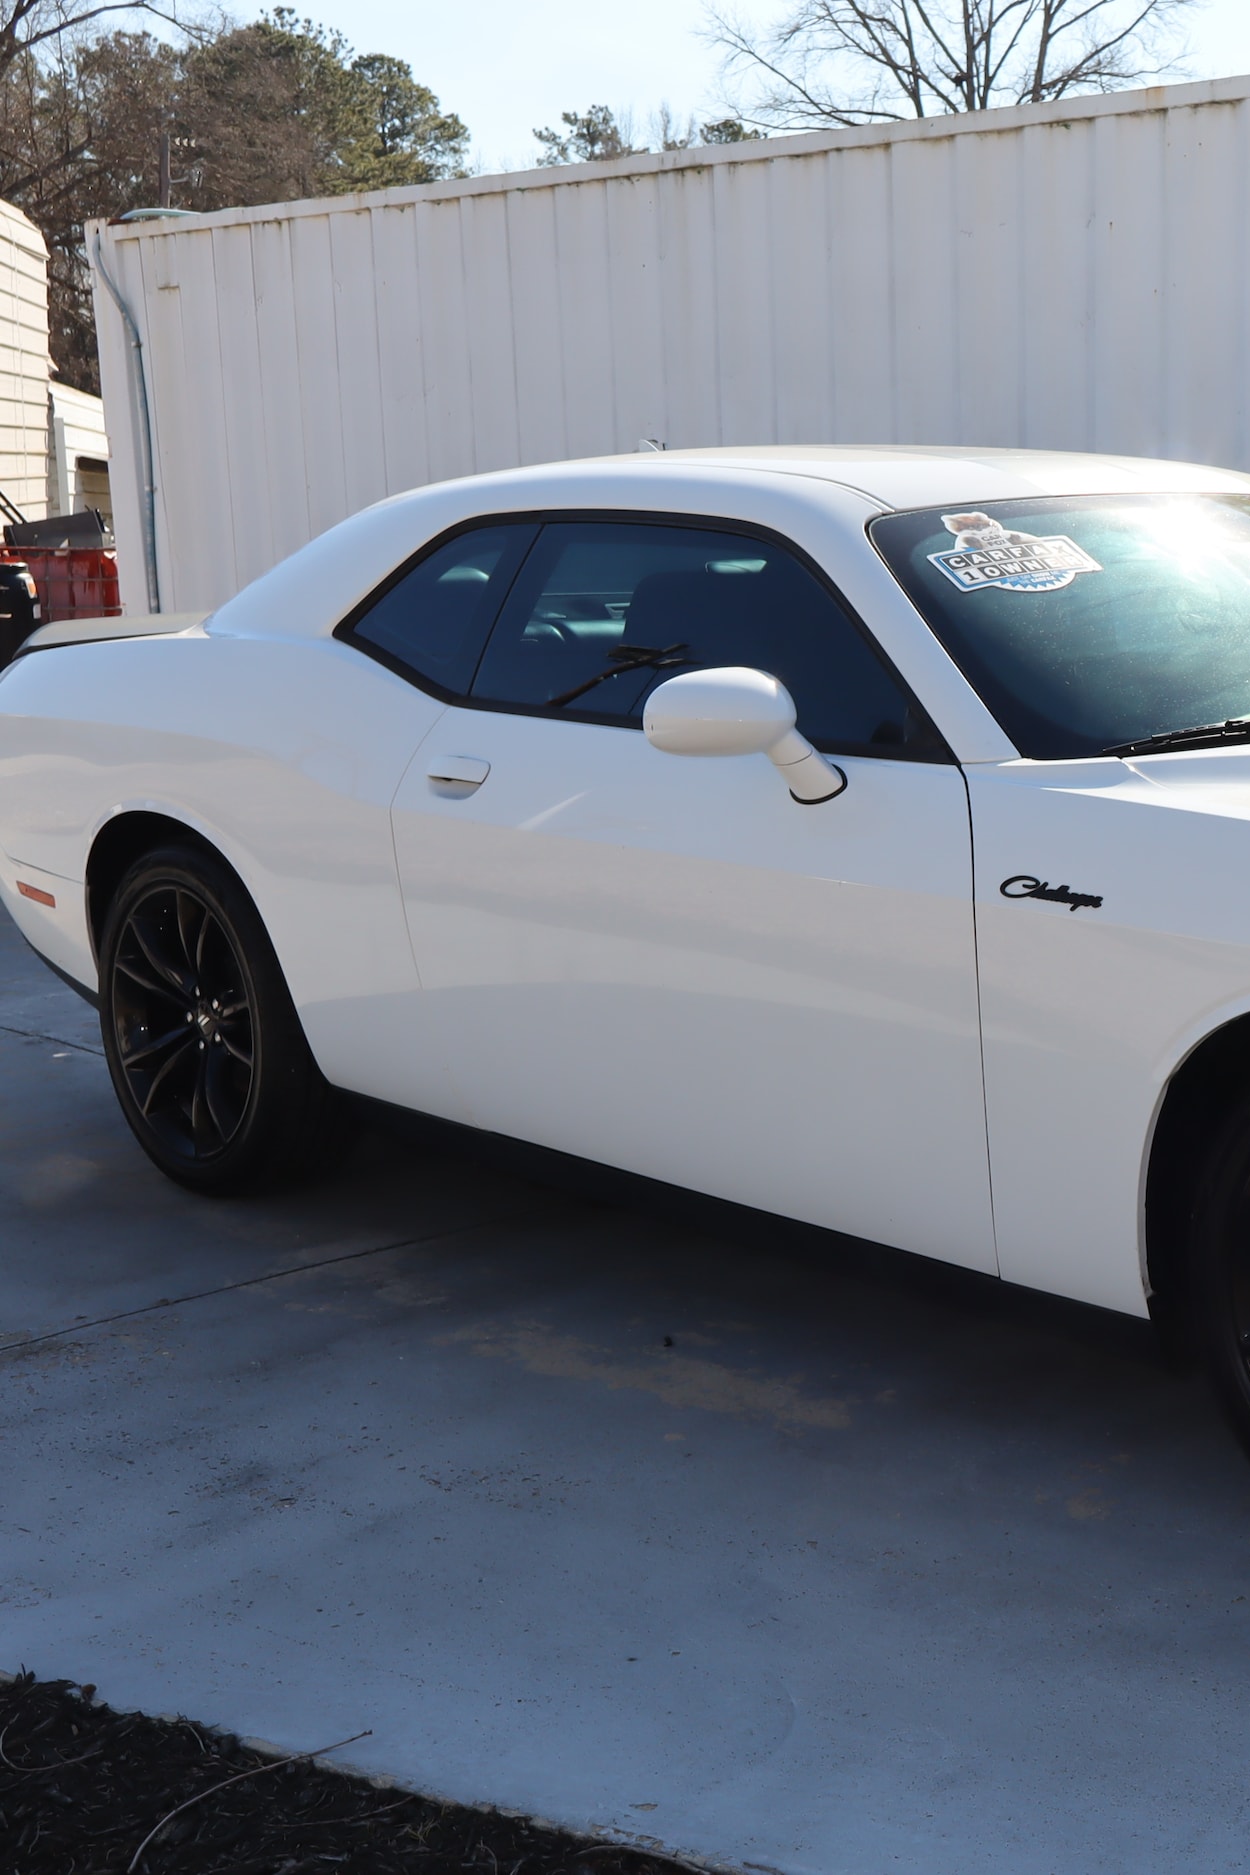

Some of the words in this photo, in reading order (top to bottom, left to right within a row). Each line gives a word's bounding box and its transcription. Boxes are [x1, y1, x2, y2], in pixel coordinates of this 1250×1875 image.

[949, 544, 1072, 569] CARFAX
[963, 571, 979, 582] 1
[983, 556, 1084, 579] OWNER
